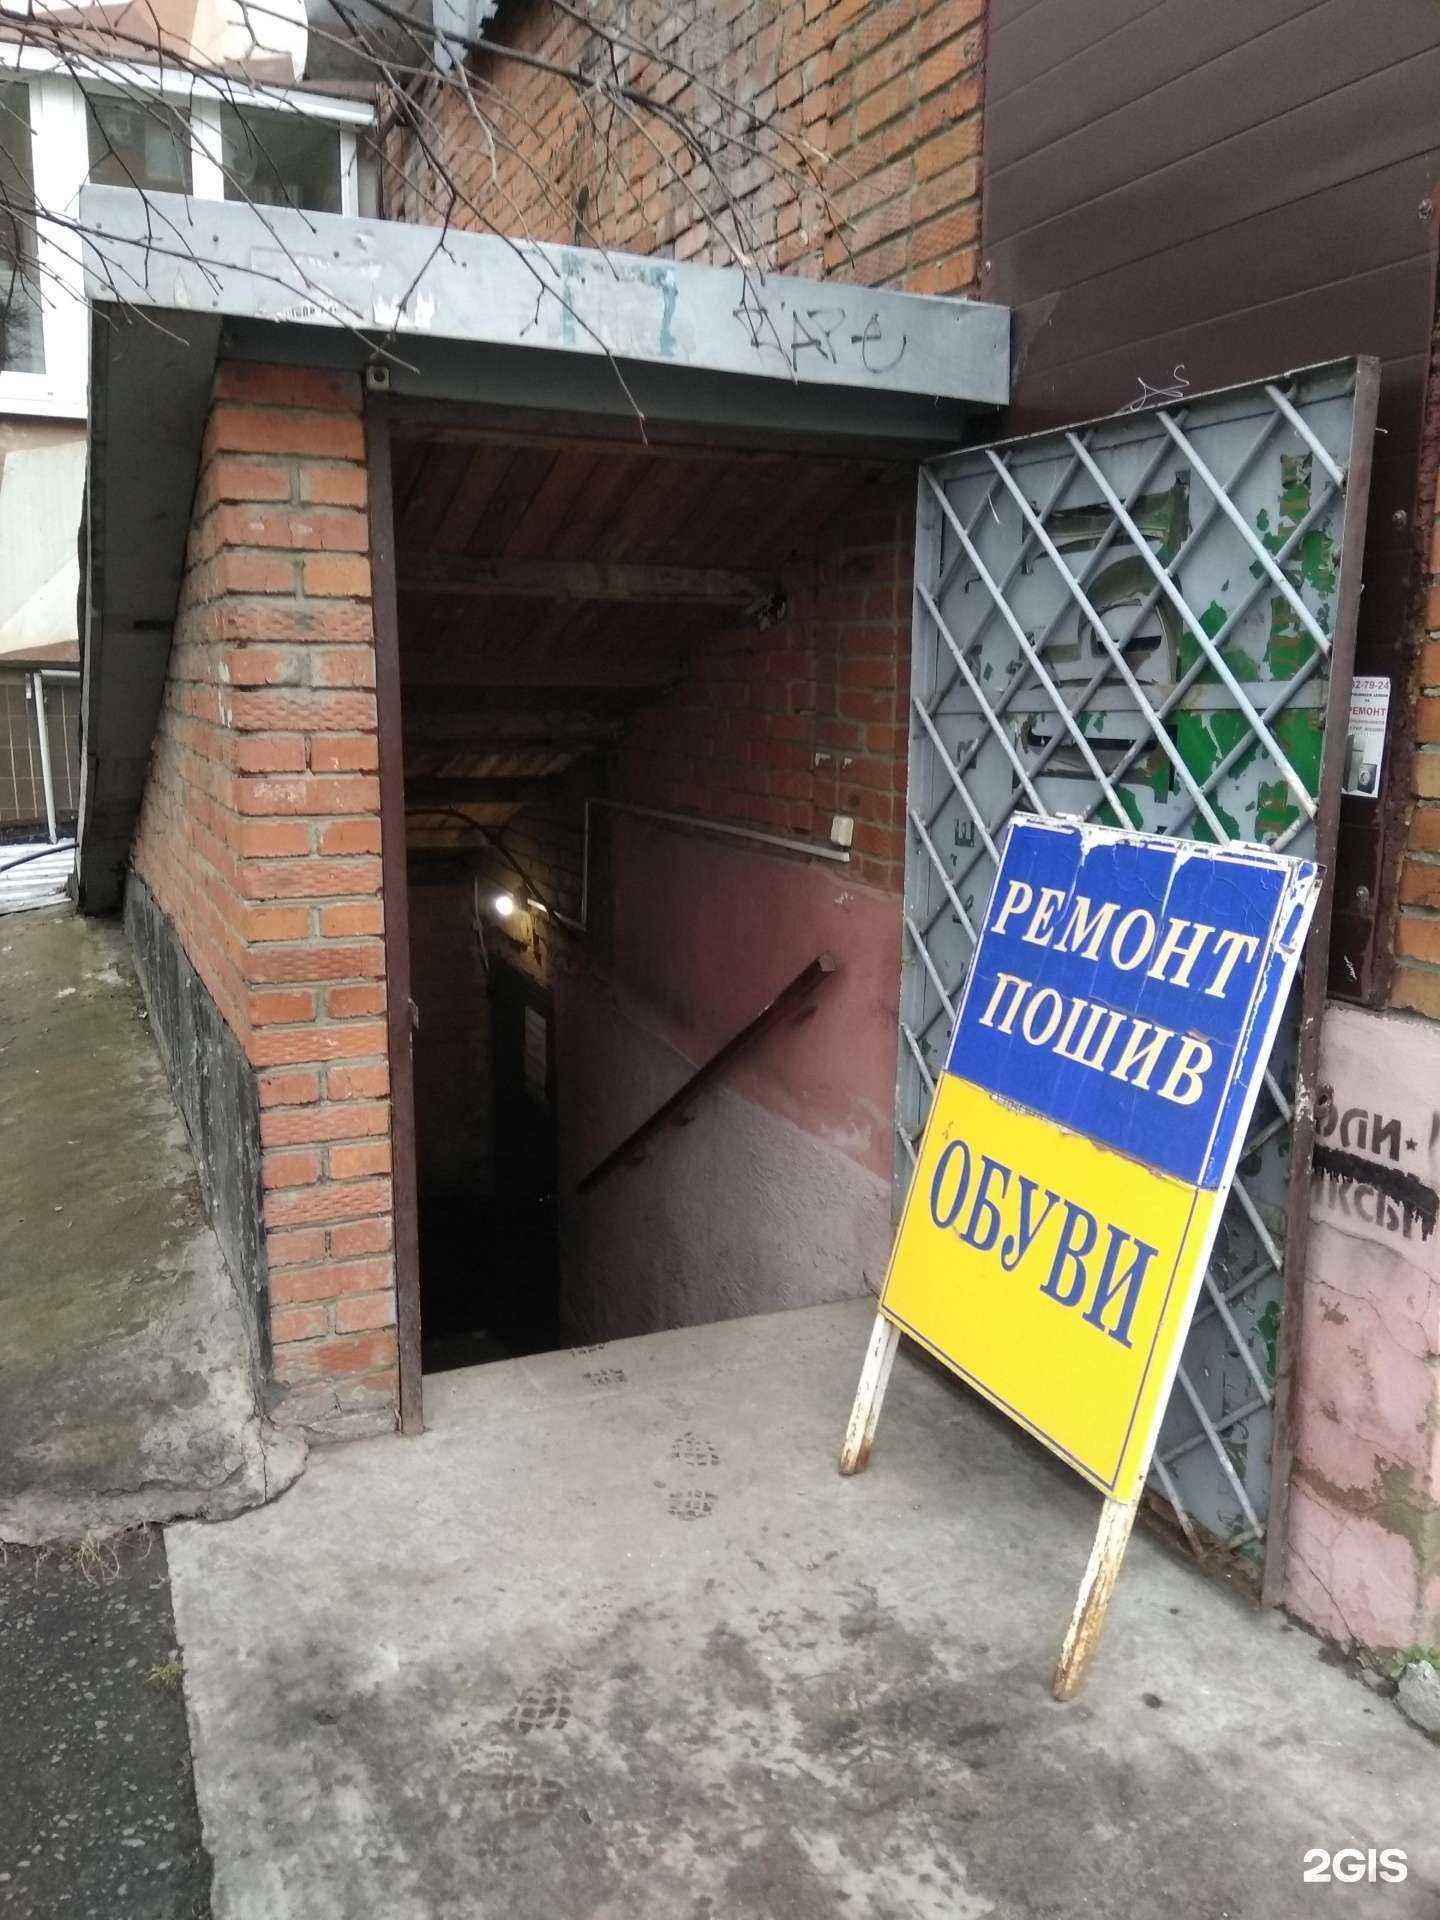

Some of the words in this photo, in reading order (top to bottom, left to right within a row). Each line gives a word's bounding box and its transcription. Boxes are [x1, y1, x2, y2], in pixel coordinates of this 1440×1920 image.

[992, 880, 1260, 998] РЕМОНТ
[979, 972, 1214, 1105] ПОШИВ
[929, 1139, 1159, 1348] ОБУВИ
